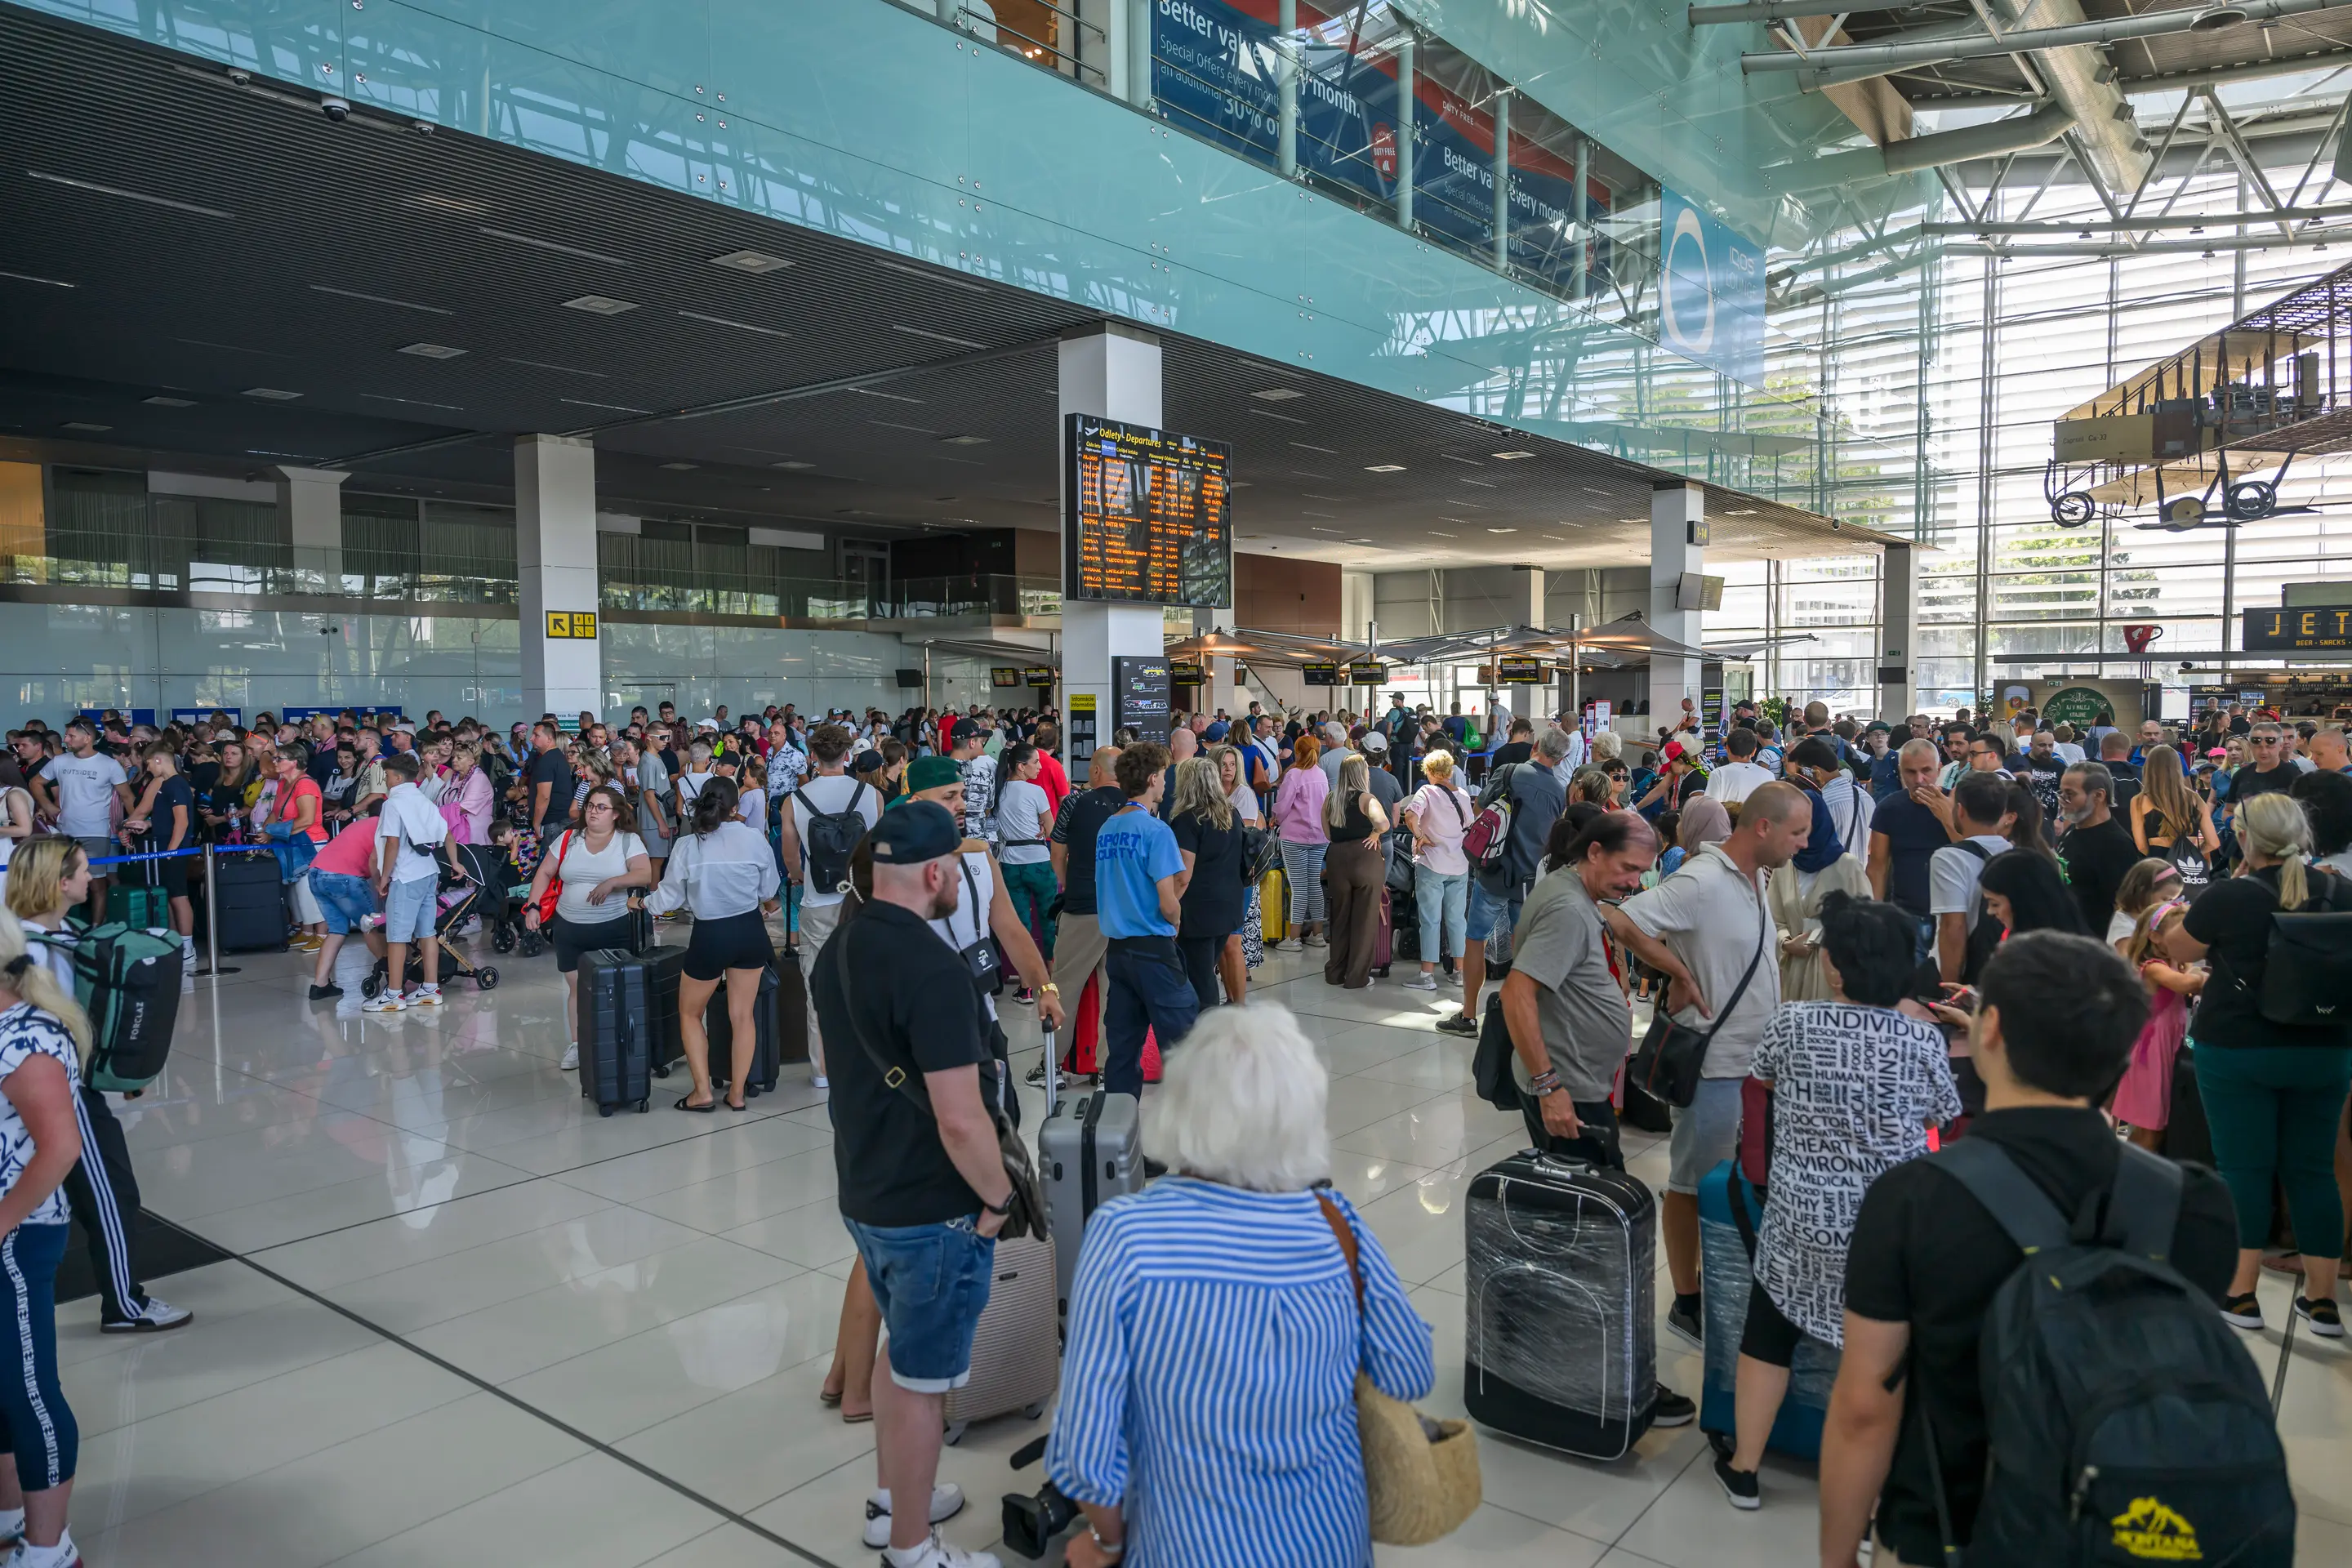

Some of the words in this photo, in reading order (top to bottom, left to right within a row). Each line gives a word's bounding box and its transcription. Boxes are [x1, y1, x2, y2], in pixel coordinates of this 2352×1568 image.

[1160, 0, 1213, 38] Better
[1160, 34, 1194, 64] Special
[1196, 53, 1225, 79] Offers
[1227, 74, 1252, 96] every
[1442, 100, 1459, 116] DUTY
[1460, 111, 1474, 126] FREE
[1374, 147, 1383, 156] DUTY
[1384, 147, 1396, 156] FREE
[1444, 146, 1478, 180] Better
[1444, 181, 1466, 202] Special
[1467, 191, 1484, 211] Offers
[1729, 245, 1754, 275] IQOS
[1099, 428, 1122, 441] Odlety
[1126, 433, 1161, 448] Departures
[130, 1001, 144, 1040] FORCLAZ
[1794, 1012, 1805, 1050] ENERGY
[1806, 1027, 1860, 1040] RESOURCE
[1864, 1034, 1876, 1072] SPORT
[1879, 1036, 1898, 1045] LIFE
[1851, 1043, 1861, 1071] FOOD
[1815, 1069, 1864, 1084] HUMAN
[1900, 1085, 1924, 1094] FOOD
[1878, 1048, 1899, 1139] VITAMINS
[1791, 1112, 1850, 1129] DOCTOR
[1851, 1087, 1868, 1147] MEDICAL
[1793, 1136, 1852, 1155] HEART
[1793, 1184, 1820, 1196] GOOD
[1799, 1173, 1858, 1187] MEDICAL
[1823, 1190, 1836, 1227] HEART
[1848, 1191, 1861, 1217] DIET
[1793, 1209, 1820, 1227] LIFE
[1816, 1285, 1828, 1321] ENERGY
[1811, 1319, 1833, 1332] VITAL
